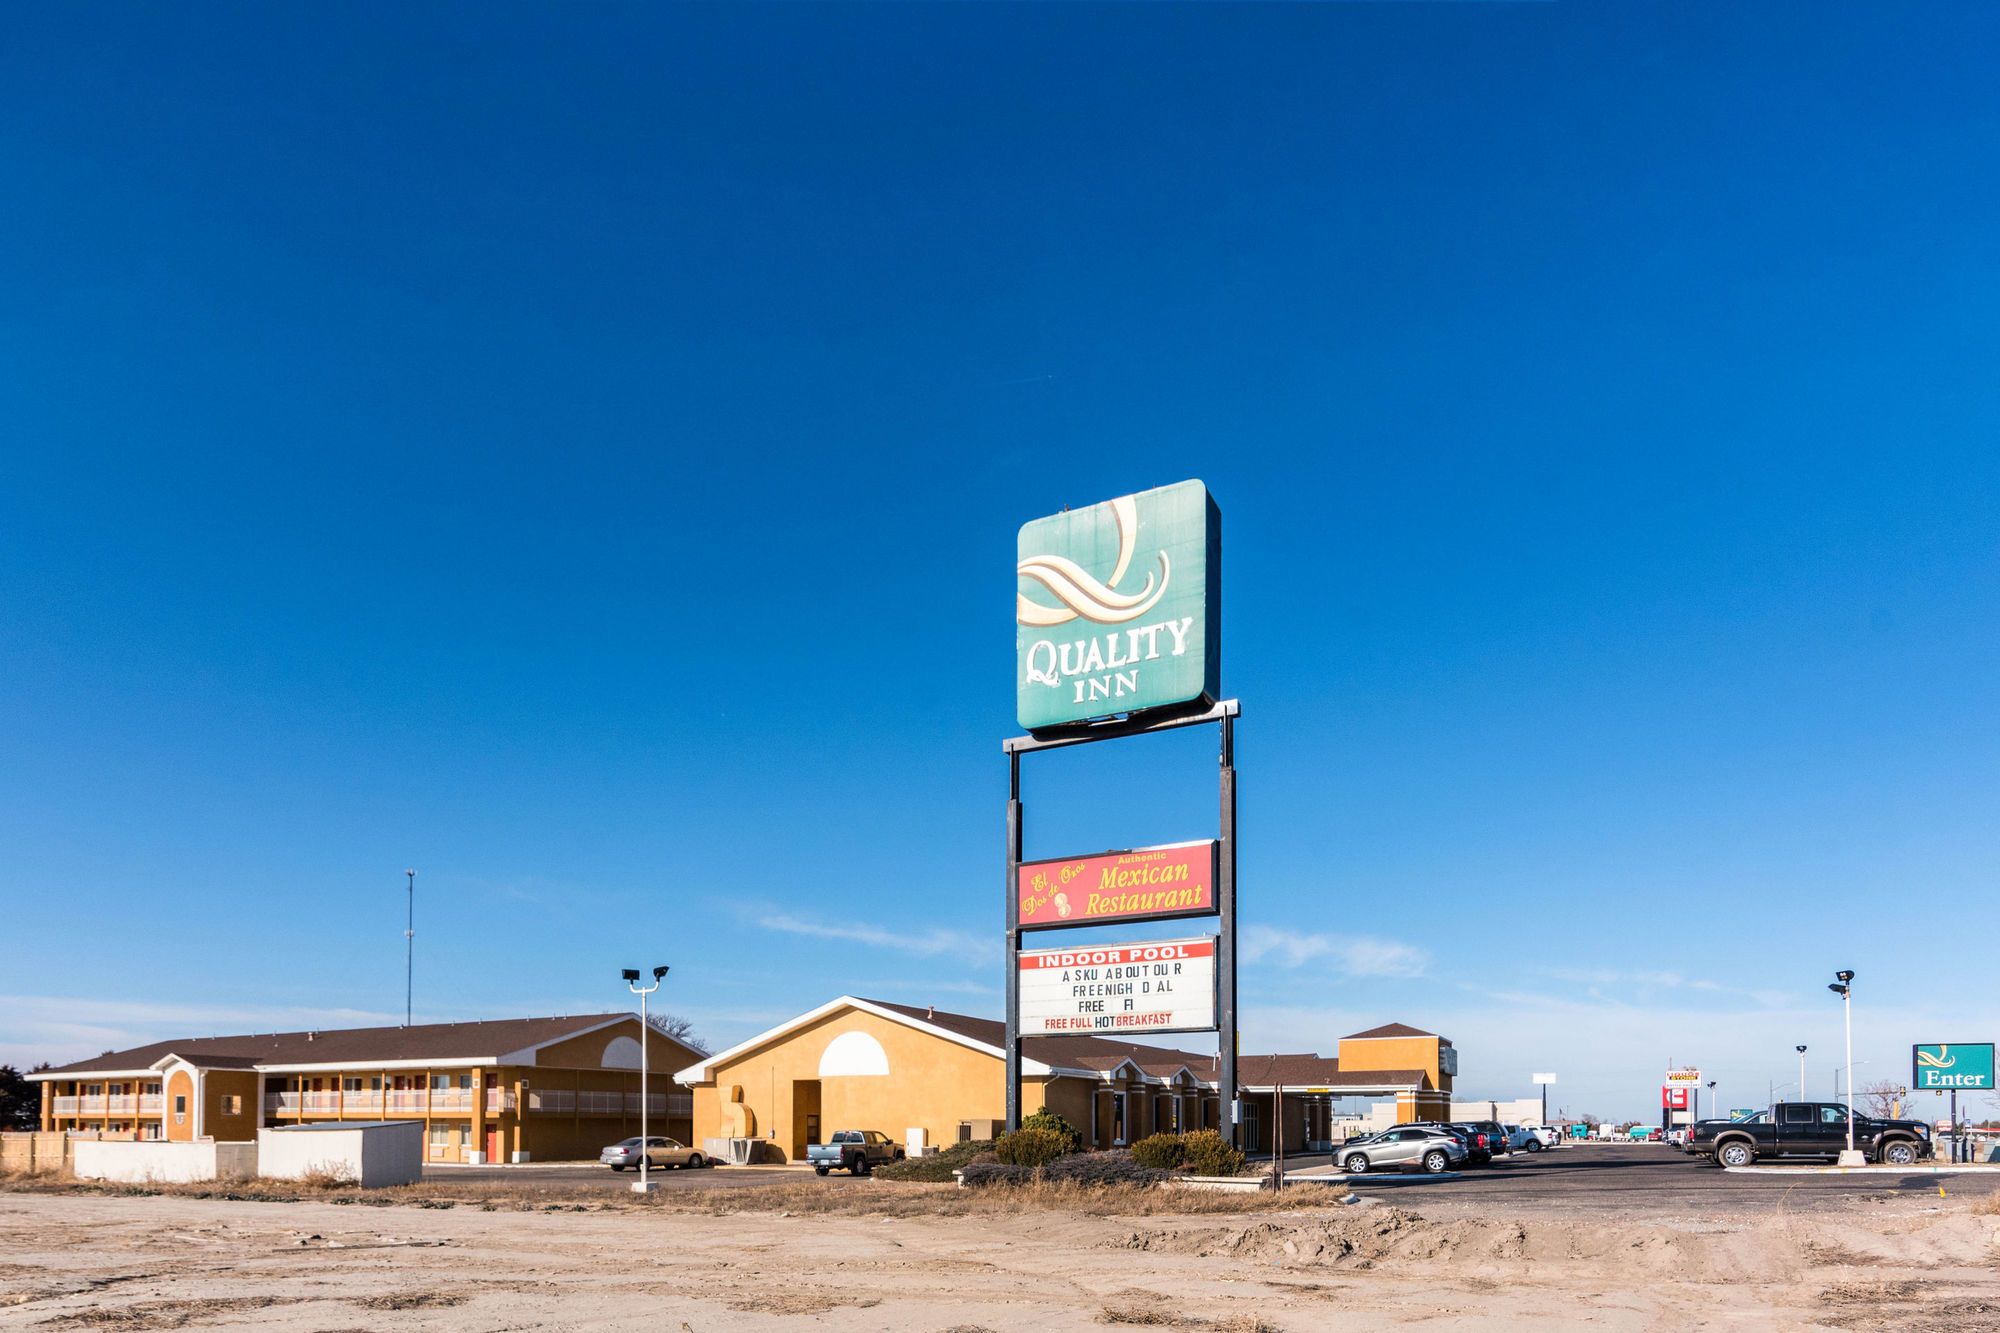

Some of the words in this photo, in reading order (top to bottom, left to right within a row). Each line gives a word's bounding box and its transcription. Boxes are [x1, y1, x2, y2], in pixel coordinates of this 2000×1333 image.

[1026, 617, 1193, 687] QUALITY
[1073, 670, 1139, 703] INN
[1117, 852, 1167, 865] Authentic
[1031, 871, 1048, 892] El
[1098, 862, 1189, 890] Mexican
[1084, 884, 1203, 915] Restaurant
[1038, 950, 1121, 968] INDOOR
[1130, 945, 1189, 961] POOL
[1078, 1000, 1104, 1013] FREE
[1045, 1018, 1067, 1029] FREE
[1070, 1017, 1092, 1029] FULL
[1925, 1070, 1985, 1086] Enter
